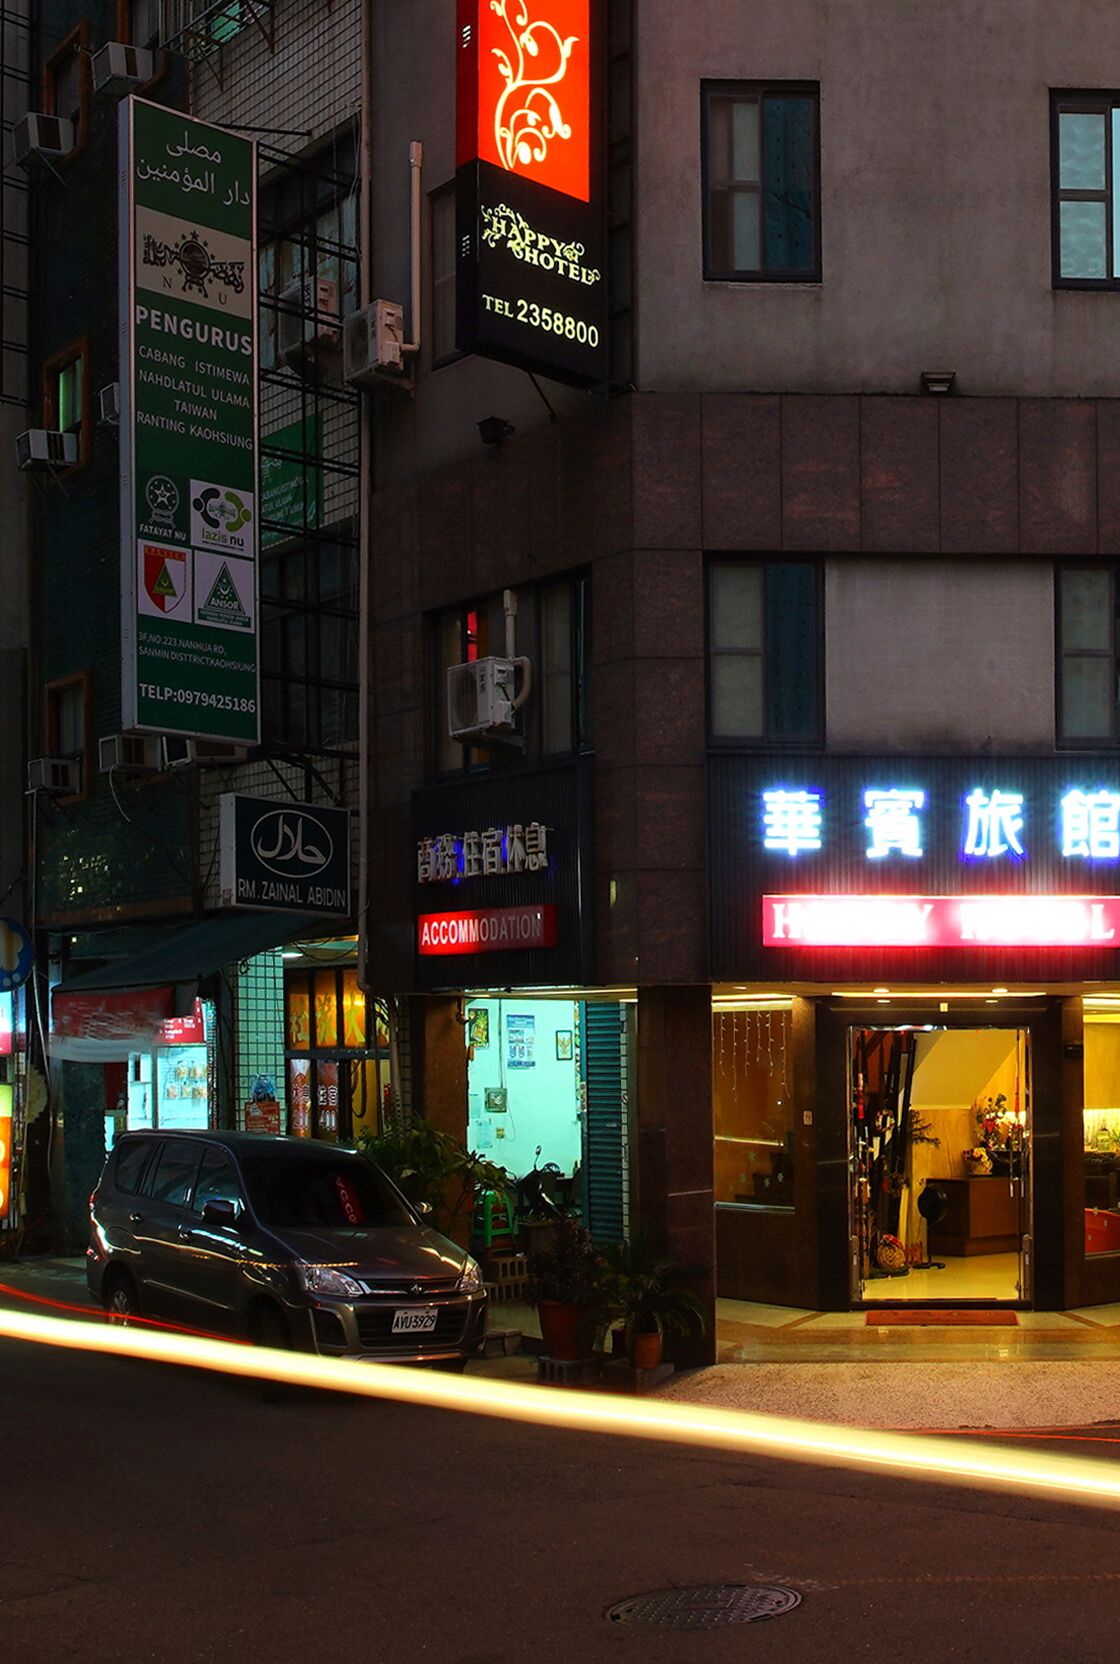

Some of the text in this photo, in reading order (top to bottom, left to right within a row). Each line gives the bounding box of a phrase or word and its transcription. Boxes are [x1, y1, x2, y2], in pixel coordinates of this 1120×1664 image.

[136, 158, 250, 206] دار المؤمنين
[490, 215, 567, 258] HAPPY
[523, 246, 597, 286] HOTEL
[136, 304, 252, 356] PENGURUS
[482, 293, 599, 348] TEL 2358800
[138, 345, 250, 385] CABANG ISTIMEWA
[138, 369, 250, 409] NAHDLATUL ULAMA
[174, 399, 218, 421] TAIWAN
[137, 411, 253, 450] RANTING KAOHSIUNG
[139, 523, 188, 542] FATAYAT NU
[230, 537, 245, 547] nu
[209, 597, 242, 612] ANSOR
[139, 682, 256, 714] TELP:0979425186
[257, 813, 327, 865] حلال
[307, 885, 346, 908] ABIDIN
[421, 914, 542, 947] ACCOMMODATION
